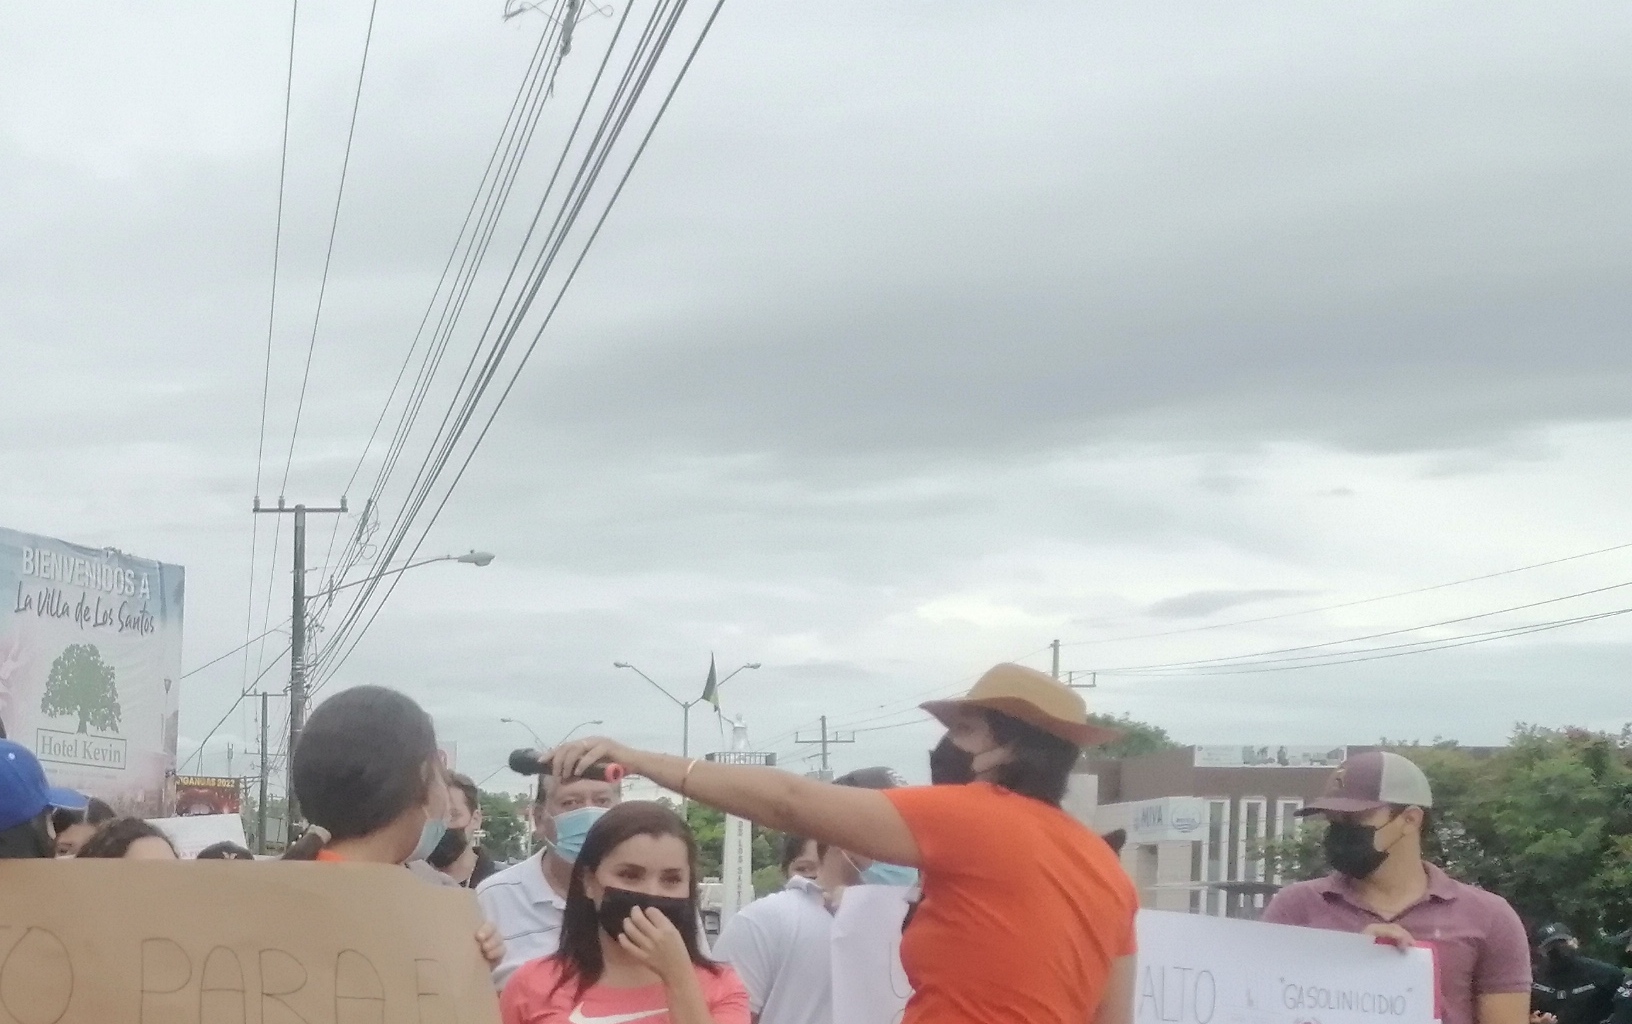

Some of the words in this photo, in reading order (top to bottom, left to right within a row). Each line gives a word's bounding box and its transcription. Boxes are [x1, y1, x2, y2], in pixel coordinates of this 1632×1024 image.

[22, 547, 135, 597] BIENVENIDOS
[140, 572, 150, 600] A
[14, 580, 32, 613] La
[37, 587, 69, 618] Villa
[74, 592, 90, 629] de
[93, 597, 114, 628] Los
[118, 601, 155, 636] Santos
[40, 735, 78, 758] Hotel
[81, 740, 121, 763] Kevin
[217, 778, 235, 788] 2022
[1139, 965, 1216, 1024] ALTO
